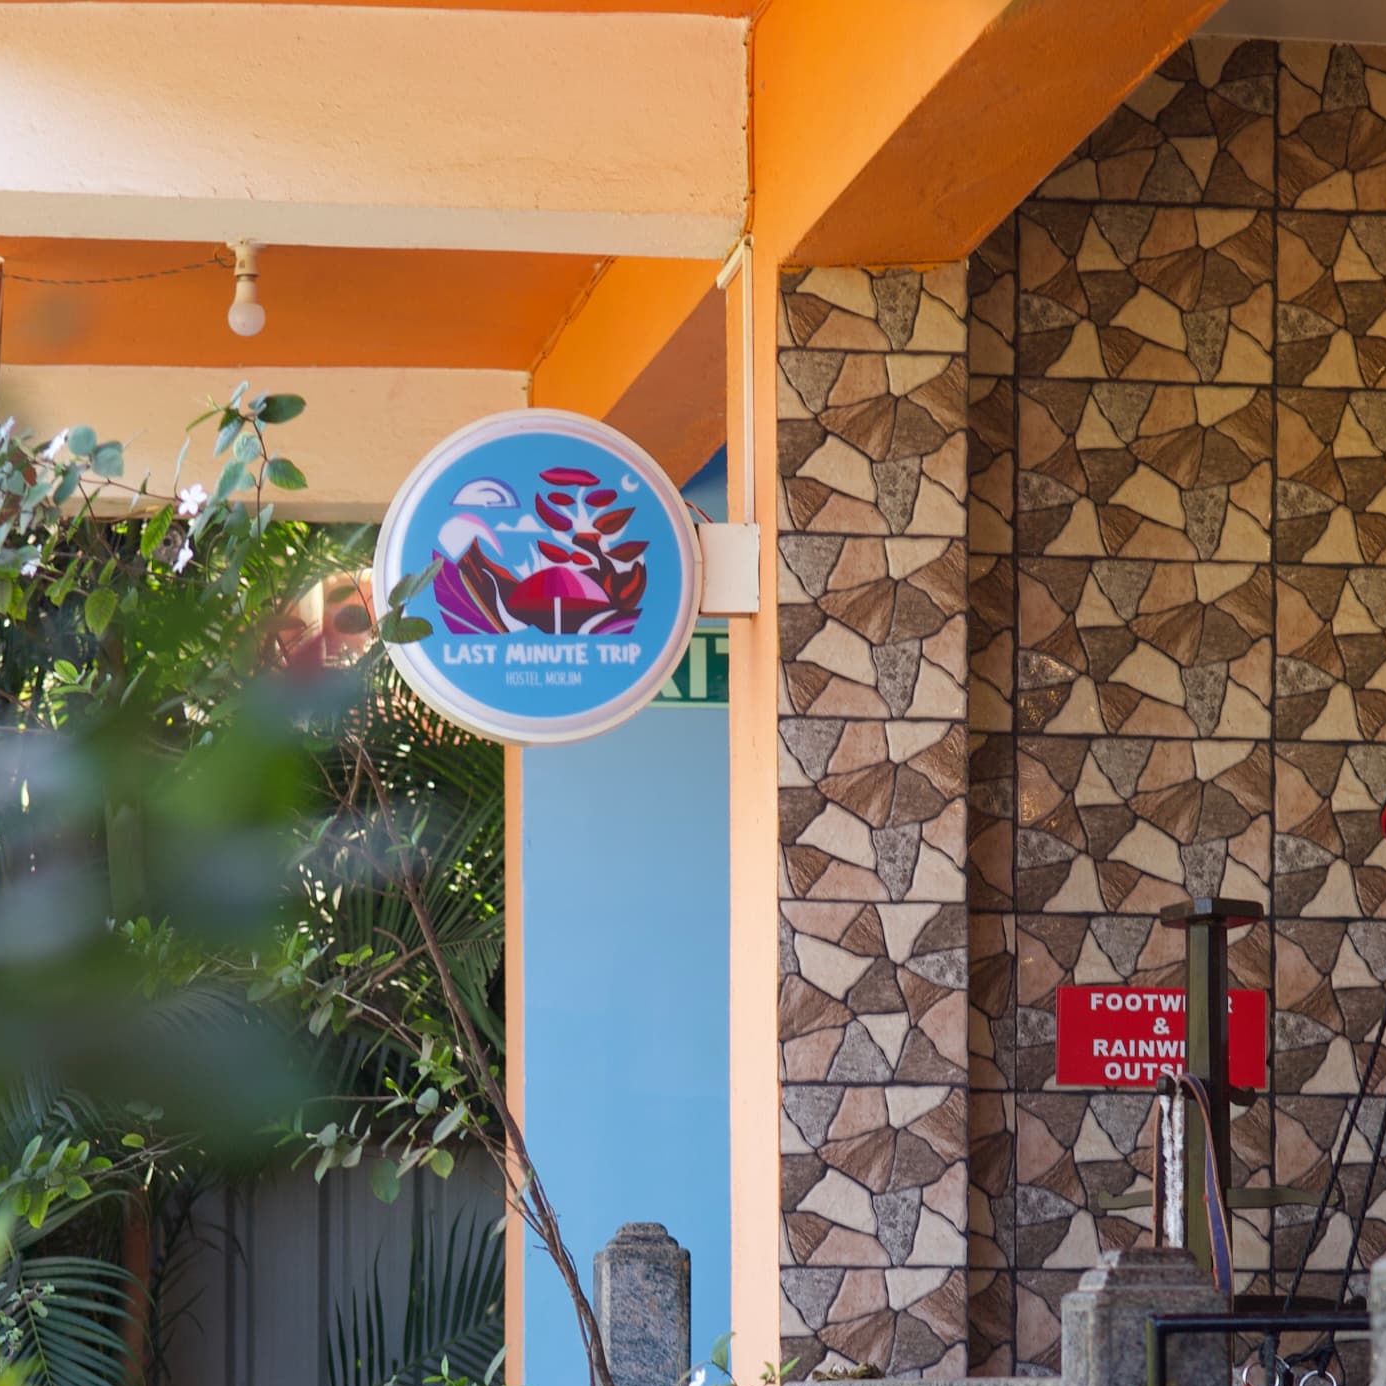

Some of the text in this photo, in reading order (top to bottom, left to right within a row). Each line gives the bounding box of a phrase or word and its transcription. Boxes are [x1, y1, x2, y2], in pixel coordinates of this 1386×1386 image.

[443, 643, 642, 665] LAST MINUTE TRIP
[506, 671, 543, 687] HOSTEL,
[1090, 993, 1233, 1014] FOOTW
[1153, 1017, 1170, 1035] &
[1093, 1039, 1186, 1058] RAINW
[1104, 1062, 1183, 1081] OUTSI
